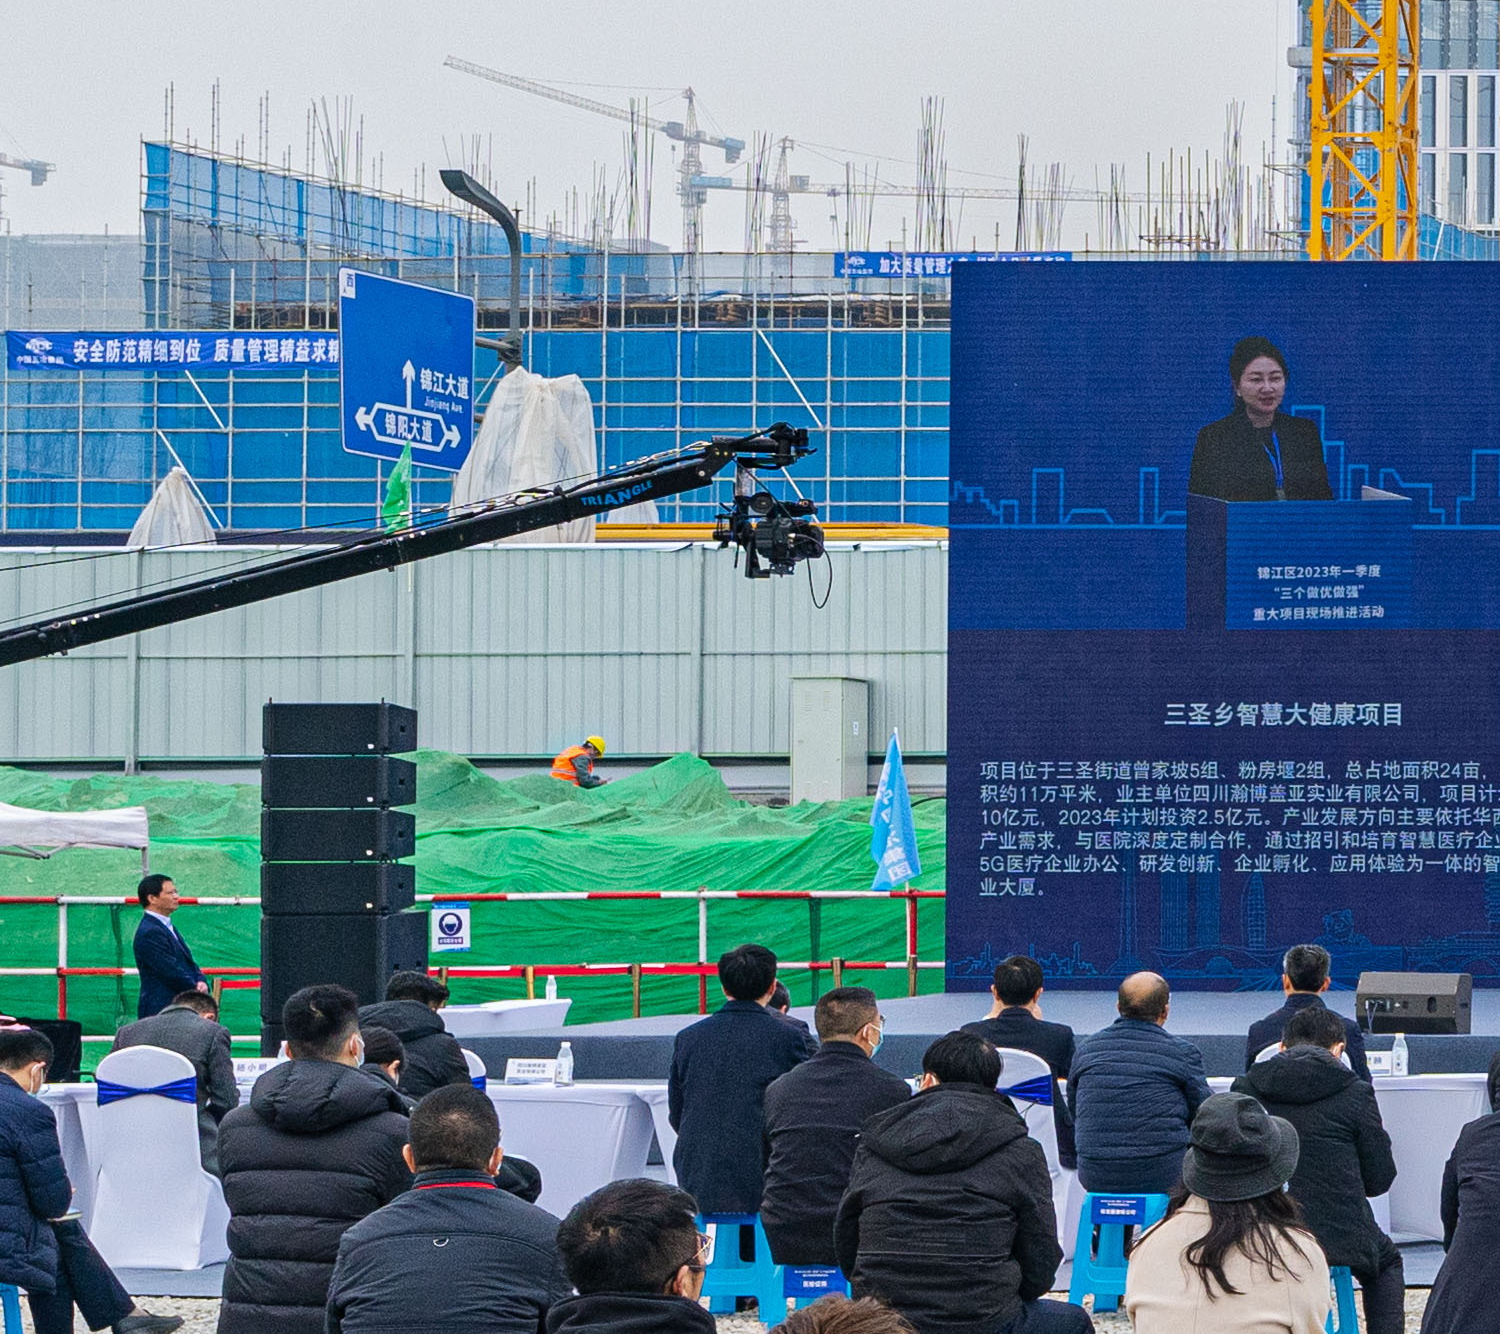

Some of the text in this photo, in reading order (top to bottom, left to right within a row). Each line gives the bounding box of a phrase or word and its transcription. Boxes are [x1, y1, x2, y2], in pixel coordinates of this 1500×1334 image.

[73, 338, 202, 364] 安全防范精细到位
[420, 367, 469, 400] 锦江大道
[384, 411, 433, 443] 锦阳大道
[581, 479, 653, 506] TRIANGLE
[1257, 564, 1381, 581] 锦江区2023年一季度
[1253, 604, 1385, 622] 重大项目现场推进活动
[1164, 702, 1403, 728] 三圣乡智慧大健康项目
[979, 878, 1045, 897] 业大厦。
